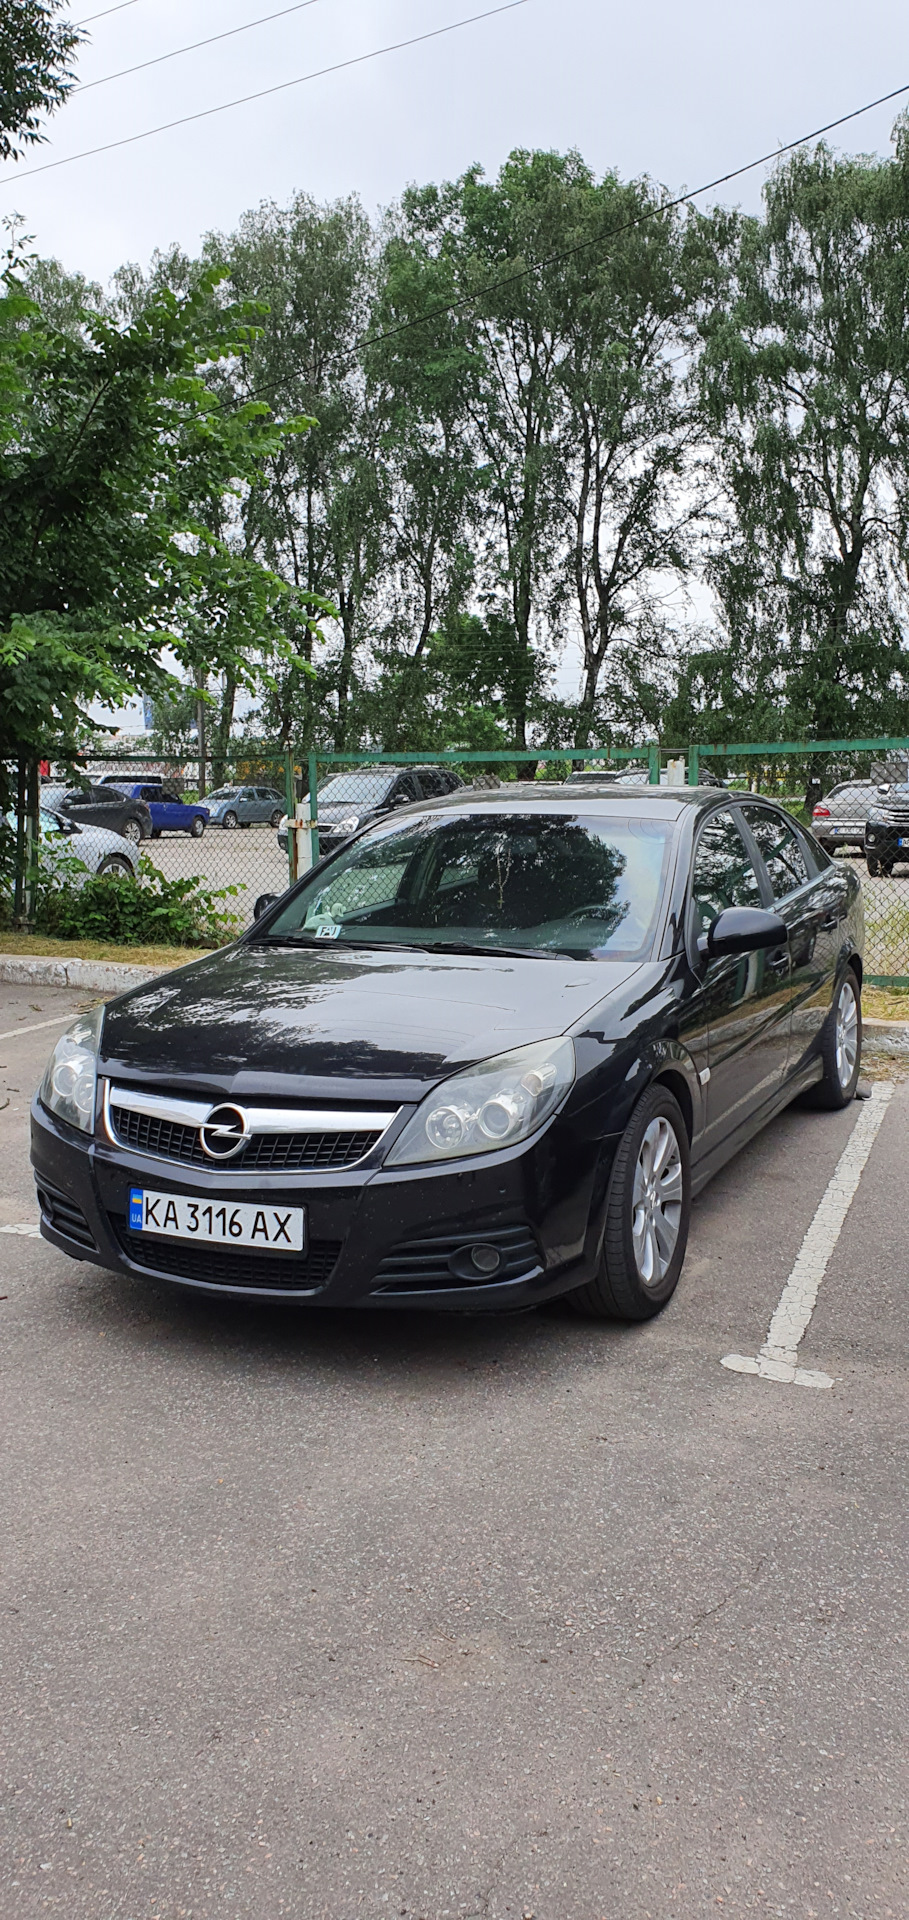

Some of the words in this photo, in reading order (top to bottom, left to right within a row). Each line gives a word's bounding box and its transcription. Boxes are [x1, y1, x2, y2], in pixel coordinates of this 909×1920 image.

[131, 1213, 142, 1223] UA
[145, 1197, 179, 1230] KA
[186, 1203, 243, 1238] 3116
[251, 1211, 292, 1243] AX
